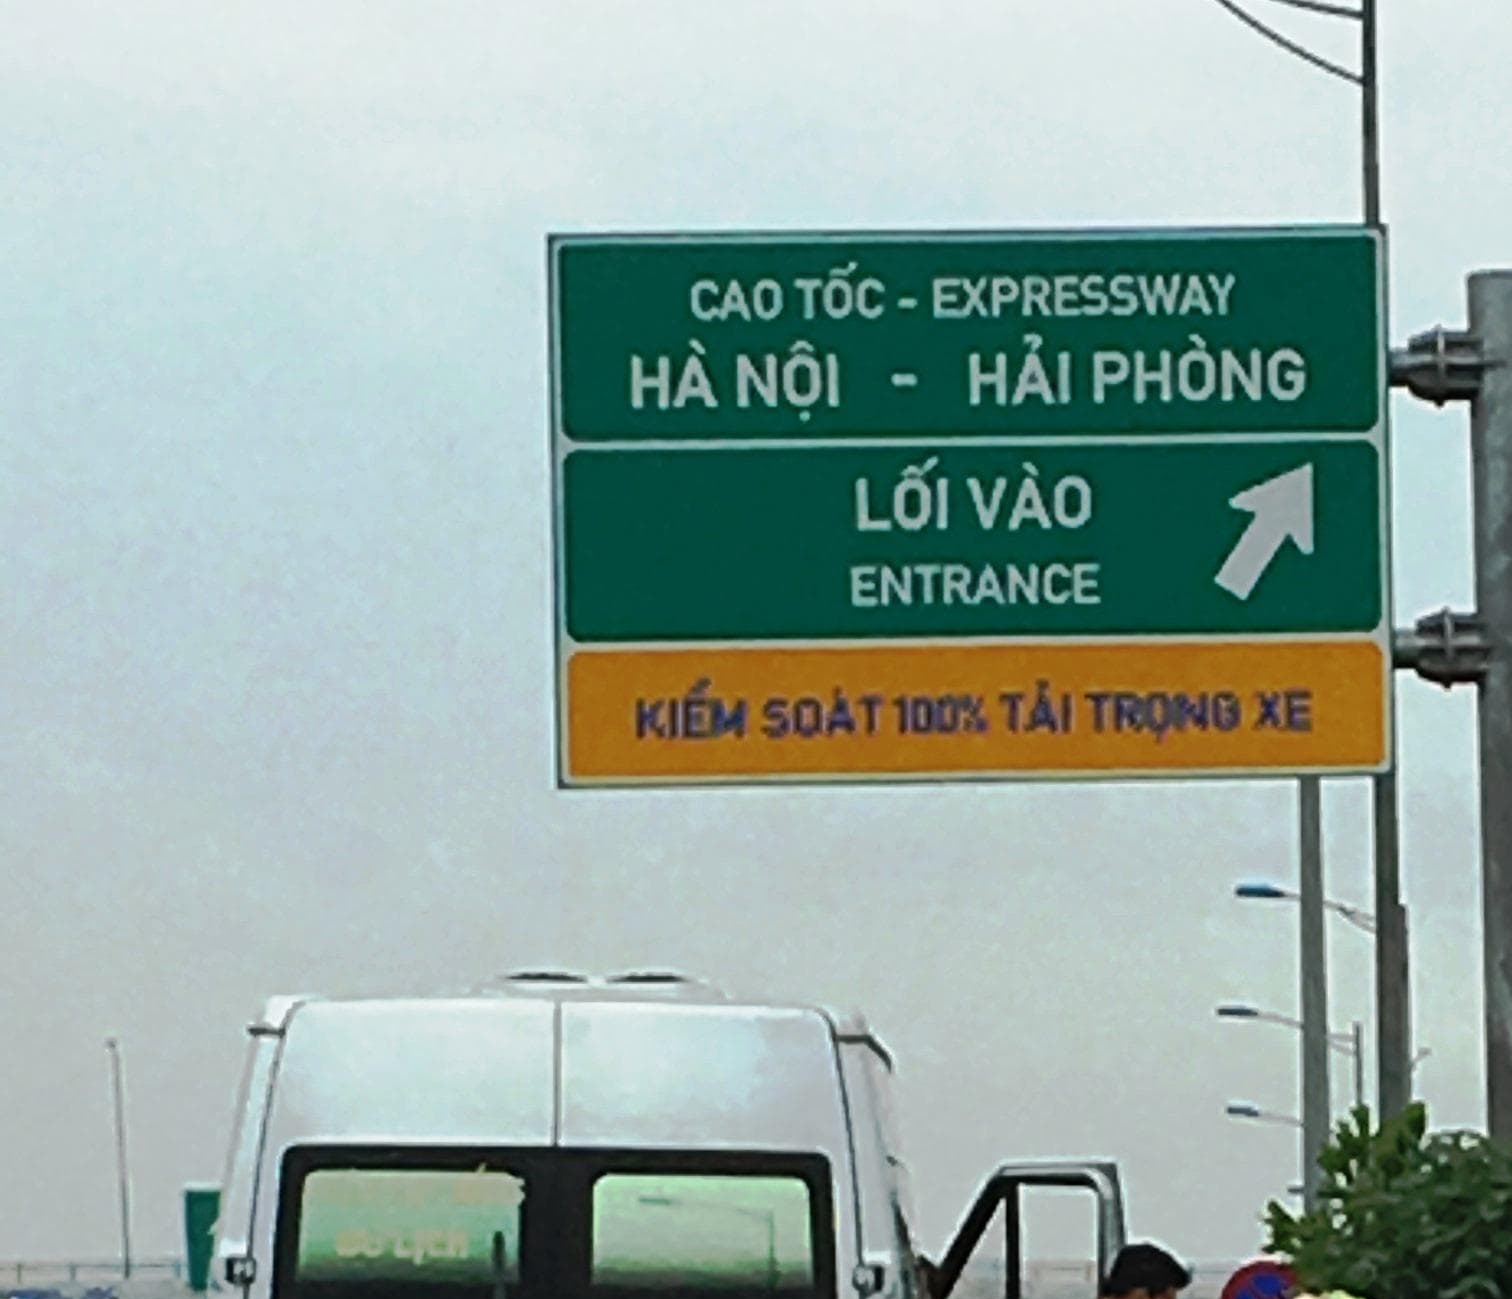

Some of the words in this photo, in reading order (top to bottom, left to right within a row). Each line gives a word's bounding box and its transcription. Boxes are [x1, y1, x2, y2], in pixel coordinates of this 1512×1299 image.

[690, 279, 783, 321] CAO
[795, 262, 885, 319] TỐC
[933, 274, 1236, 318] EXPRESSWAY
[630, 339, 718, 410] HÀ
[736, 340, 840, 421] NỘI
[969, 333, 1071, 405] HẢI
[1093, 334, 1307, 404] PHÒNG
[855, 456, 949, 531] LỐI
[967, 462, 1092, 530] VÀO
[850, 563, 1101, 607] ENTRANCE
[892, 693, 989, 735] 100%
[1083, 690, 1242, 743] TRỌNG
[1254, 687, 1313, 732] XE
